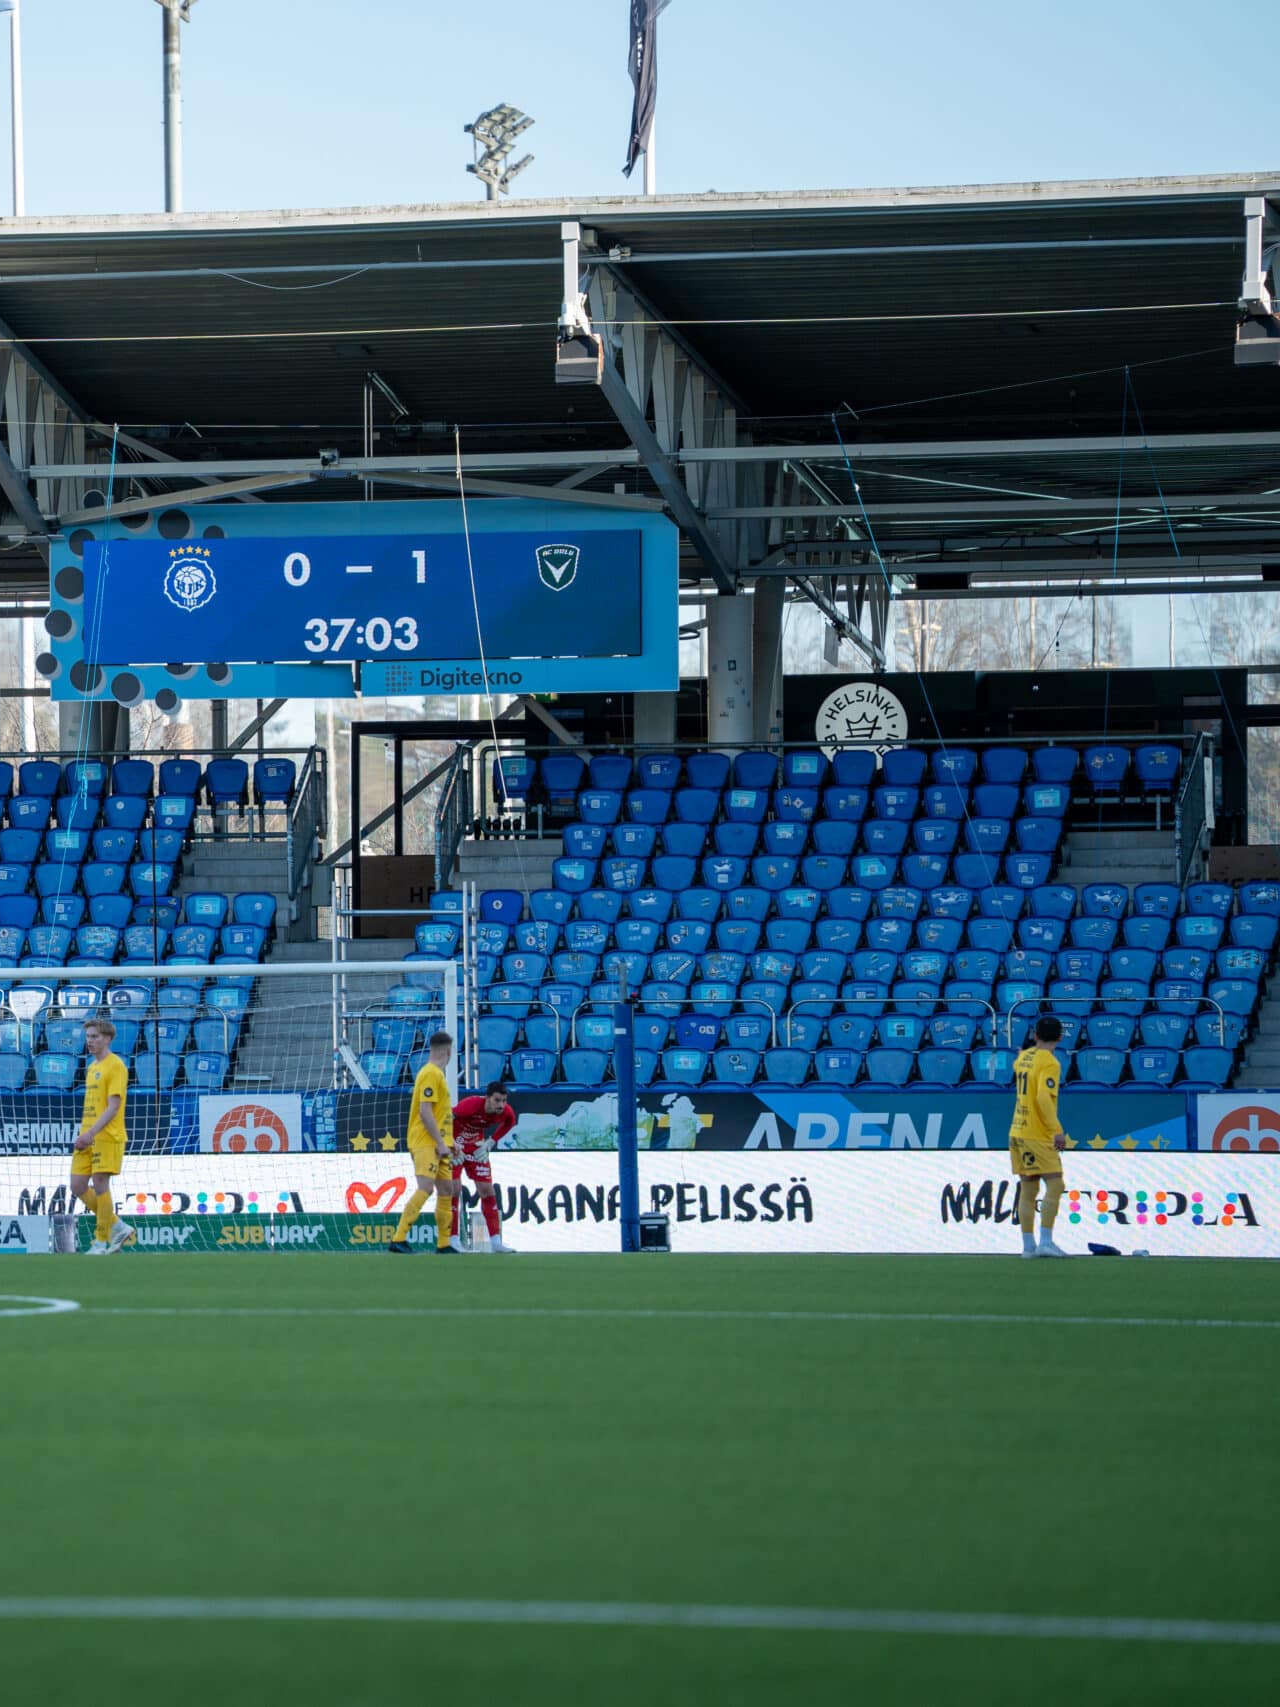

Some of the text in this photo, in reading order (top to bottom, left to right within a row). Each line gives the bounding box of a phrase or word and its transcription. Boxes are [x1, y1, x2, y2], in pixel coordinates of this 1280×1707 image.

[284, 551, 310, 587] 0
[411, 550, 426, 583] 1
[304, 618, 419, 653] 37:03
[420, 667, 523, 688] Digitekno
[825, 689, 899, 720] HELSINKI
[1017, 1071, 1028, 1095] 11
[650, 1177, 814, 1223] PELISSÄ
[1062, 1189, 1262, 1226] TRIPLA
[218, 1224, 325, 1245] SUBWAY
